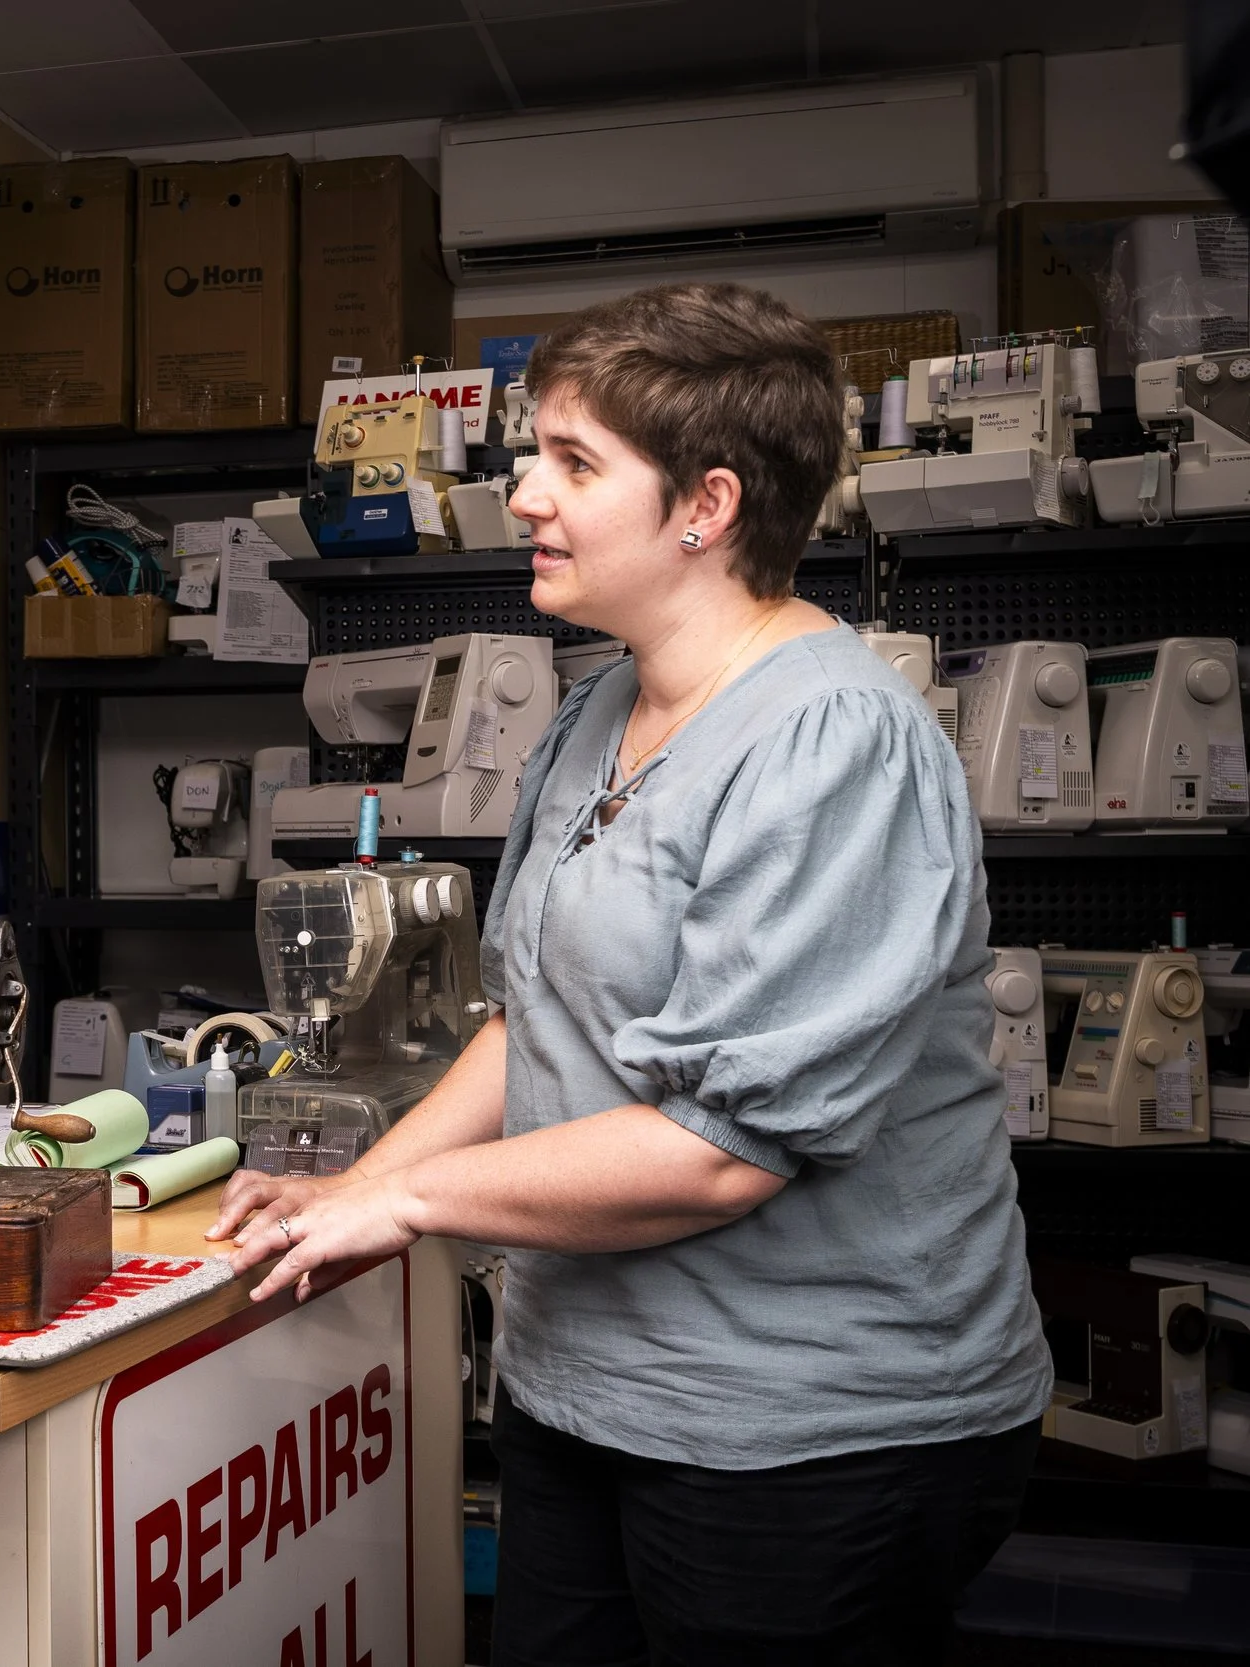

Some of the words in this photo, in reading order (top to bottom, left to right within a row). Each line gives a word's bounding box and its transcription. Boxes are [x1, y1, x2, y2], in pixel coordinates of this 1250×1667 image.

[44, 265, 101, 286] Horn
[203, 265, 263, 285] Horn
[979, 413, 1001, 421] PFAFF
[186, 785, 210, 796] DON
[135, 1363, 393, 1663] REPAIRS
